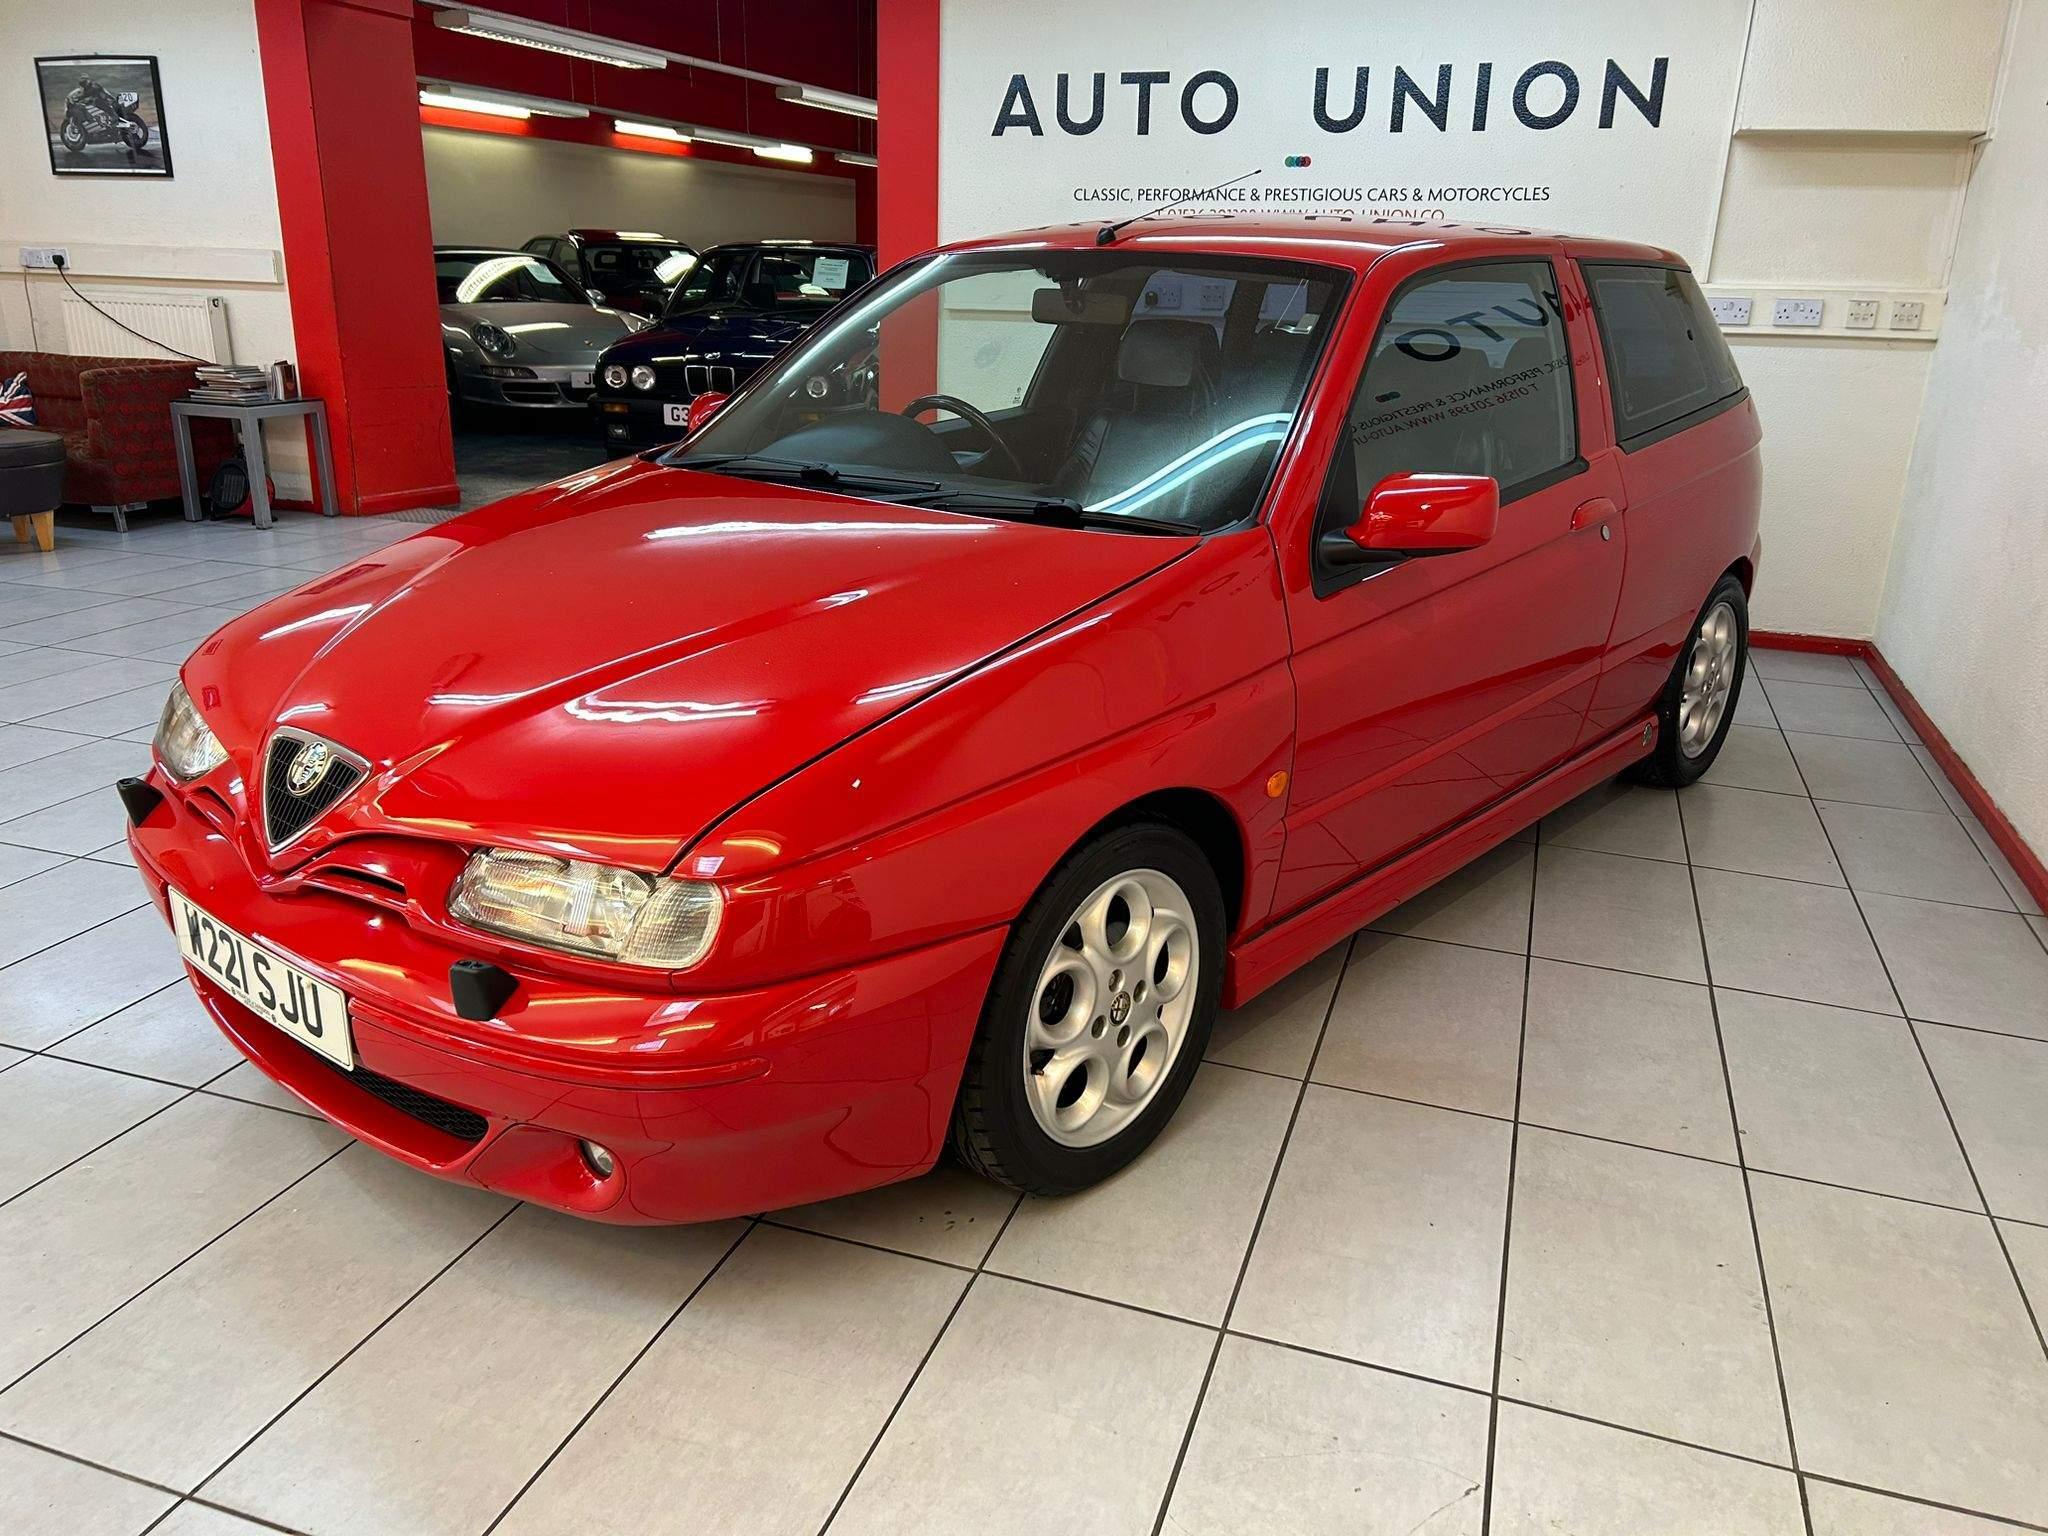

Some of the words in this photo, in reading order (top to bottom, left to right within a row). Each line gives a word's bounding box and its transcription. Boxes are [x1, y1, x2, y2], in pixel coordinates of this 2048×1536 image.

[991, 70, 1239, 137] AUTO
[1313, 57, 1669, 134] UNION
[1073, 188, 1133, 203] CLASSIC,
[1137, 188, 1246, 201] PERFORMANCE
[1250, 187, 1260, 201] &
[1264, 188, 1362, 201] PRESTIGIOUS
[1367, 187, 1408, 201] CARS
[1412, 187, 1423, 201] &
[1428, 186, 1550, 201] MOTORCYCLES
[671, 406, 689, 422] G3
[184, 902, 249, 994] W221
[252, 952, 323, 1039] SJU
